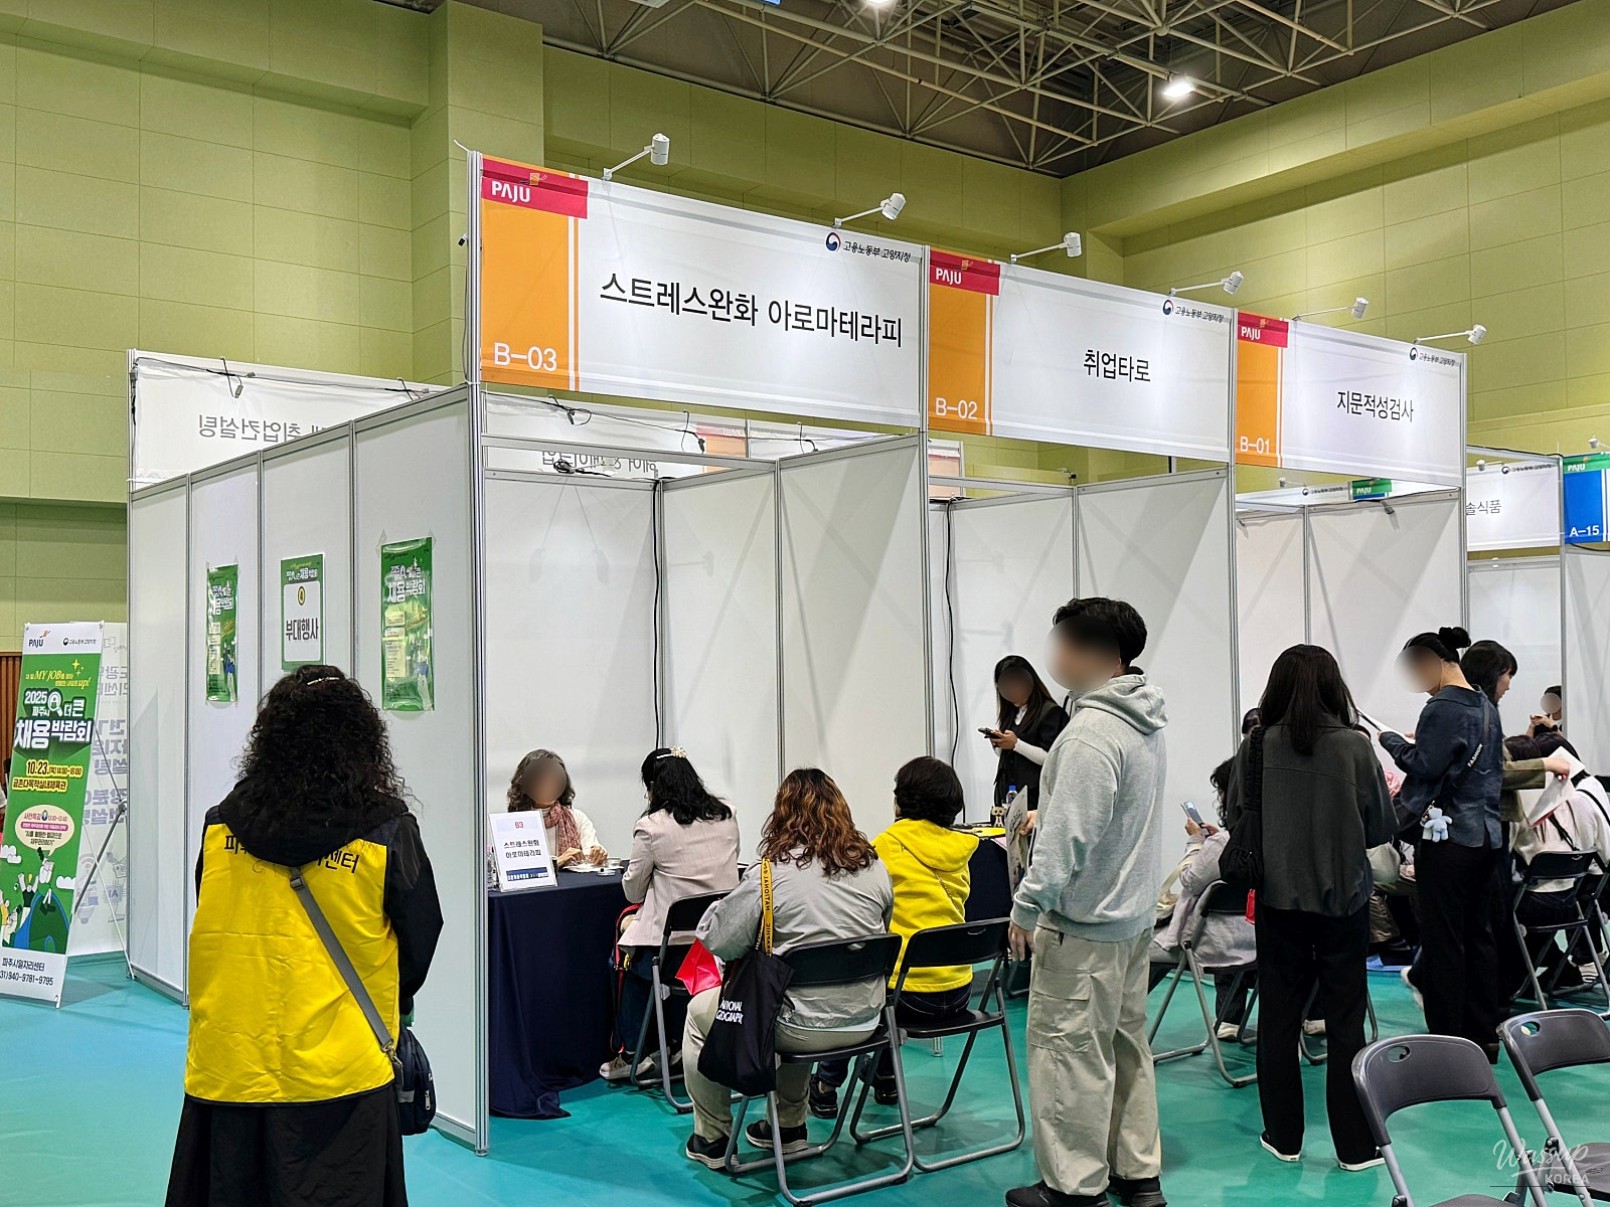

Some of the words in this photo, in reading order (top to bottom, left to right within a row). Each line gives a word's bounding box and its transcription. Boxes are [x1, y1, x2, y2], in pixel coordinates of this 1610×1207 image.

[491, 180, 532, 203] PAJU
[843, 240, 881, 257] 고용노동부
[935, 267, 962, 285] PAJU
[600, 272, 758, 327] 스트레스완화
[768, 299, 903, 348] 아로마테라피
[1240, 325, 1261, 341] PAJU
[494, 342, 557, 372] B-03
[1083, 349, 1151, 382] 취업타로
[935, 397, 978, 421] B-02
[1337, 390, 1414, 423] 지문적성검사
[1240, 436, 1270, 455] B-01
[1567, 463, 1586, 472] PAJU
[1569, 525, 1600, 537] A-15
[286, 617, 319, 641] 부대행사
[28, 639, 44, 648] PAJU
[24, 690, 48, 704] 2025
